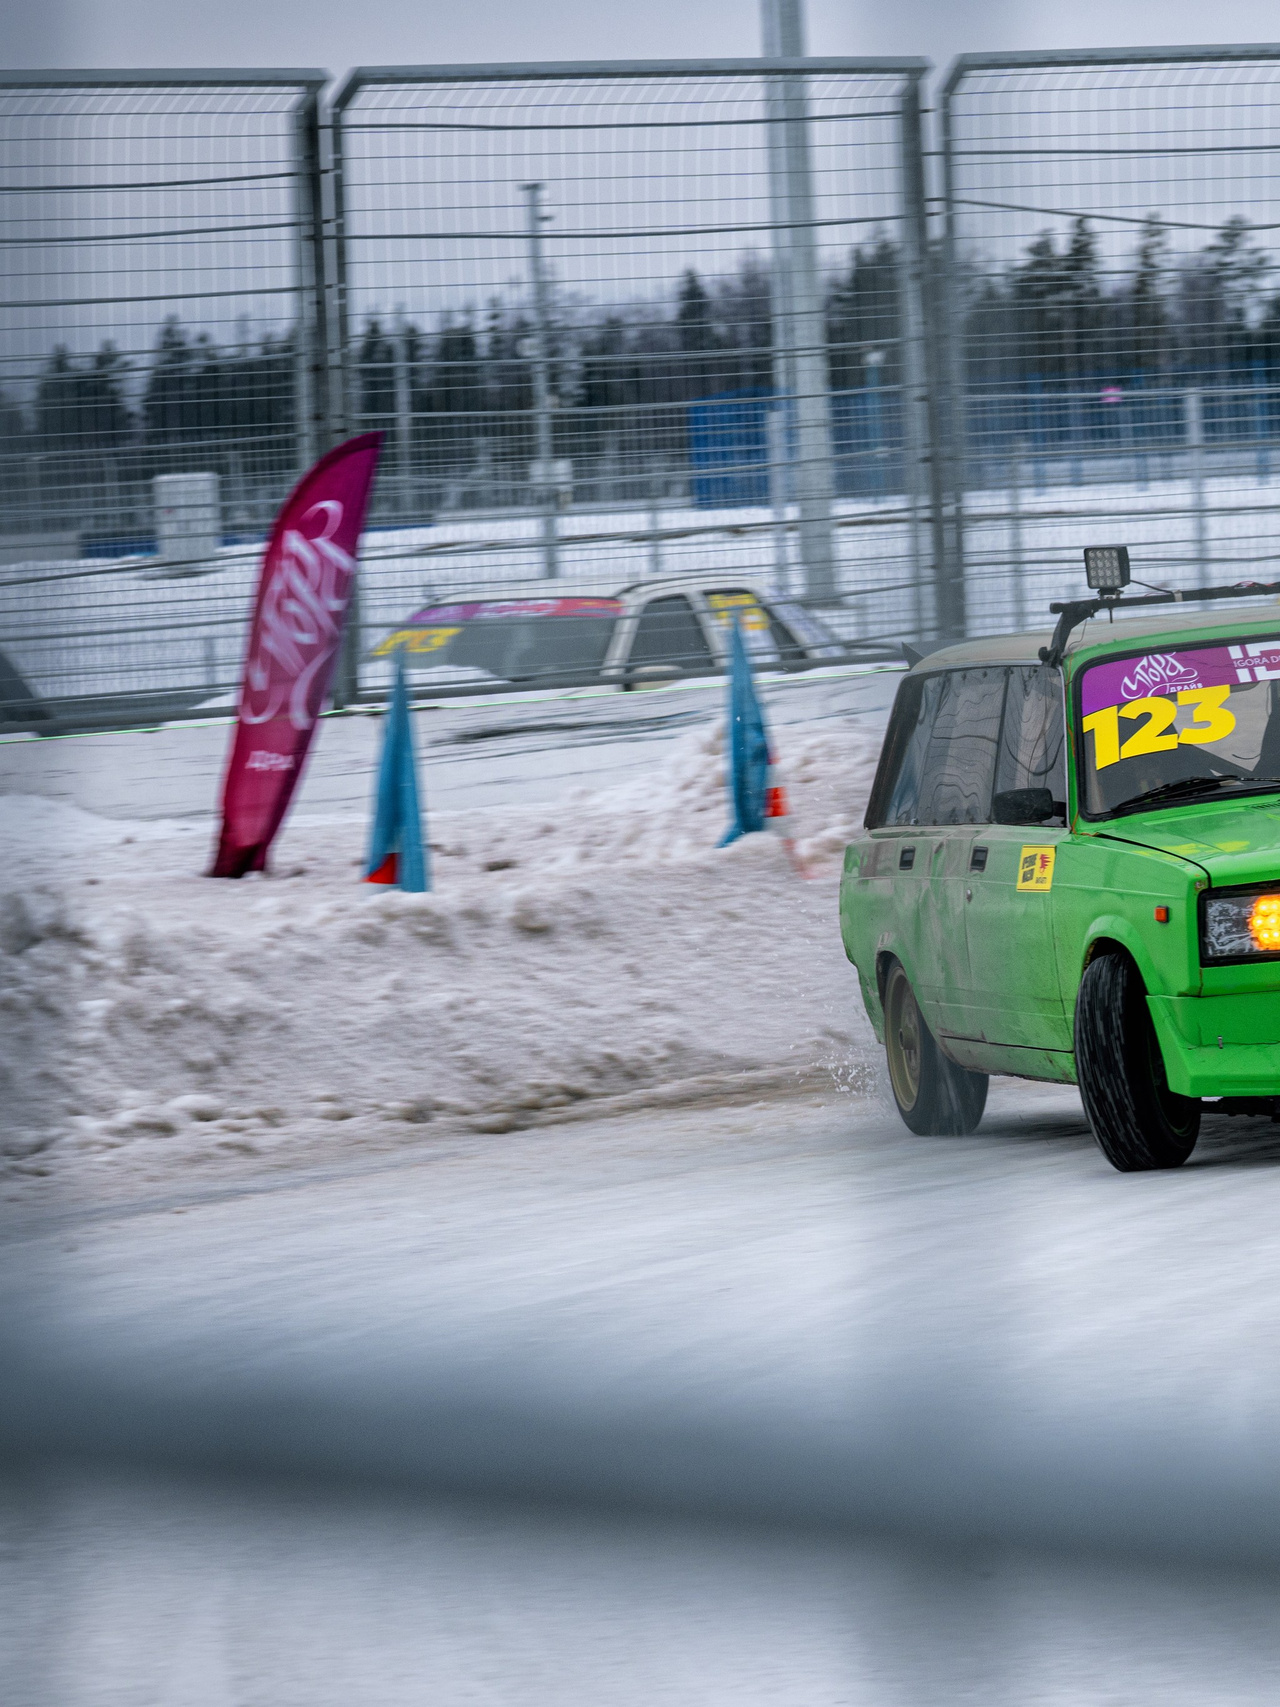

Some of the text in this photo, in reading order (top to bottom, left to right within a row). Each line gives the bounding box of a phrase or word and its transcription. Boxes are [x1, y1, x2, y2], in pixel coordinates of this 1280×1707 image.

[1233, 656, 1270, 668] IGORA
[1169, 682, 1203, 693] ДРАЙВ
[1082, 684, 1236, 771] 123
